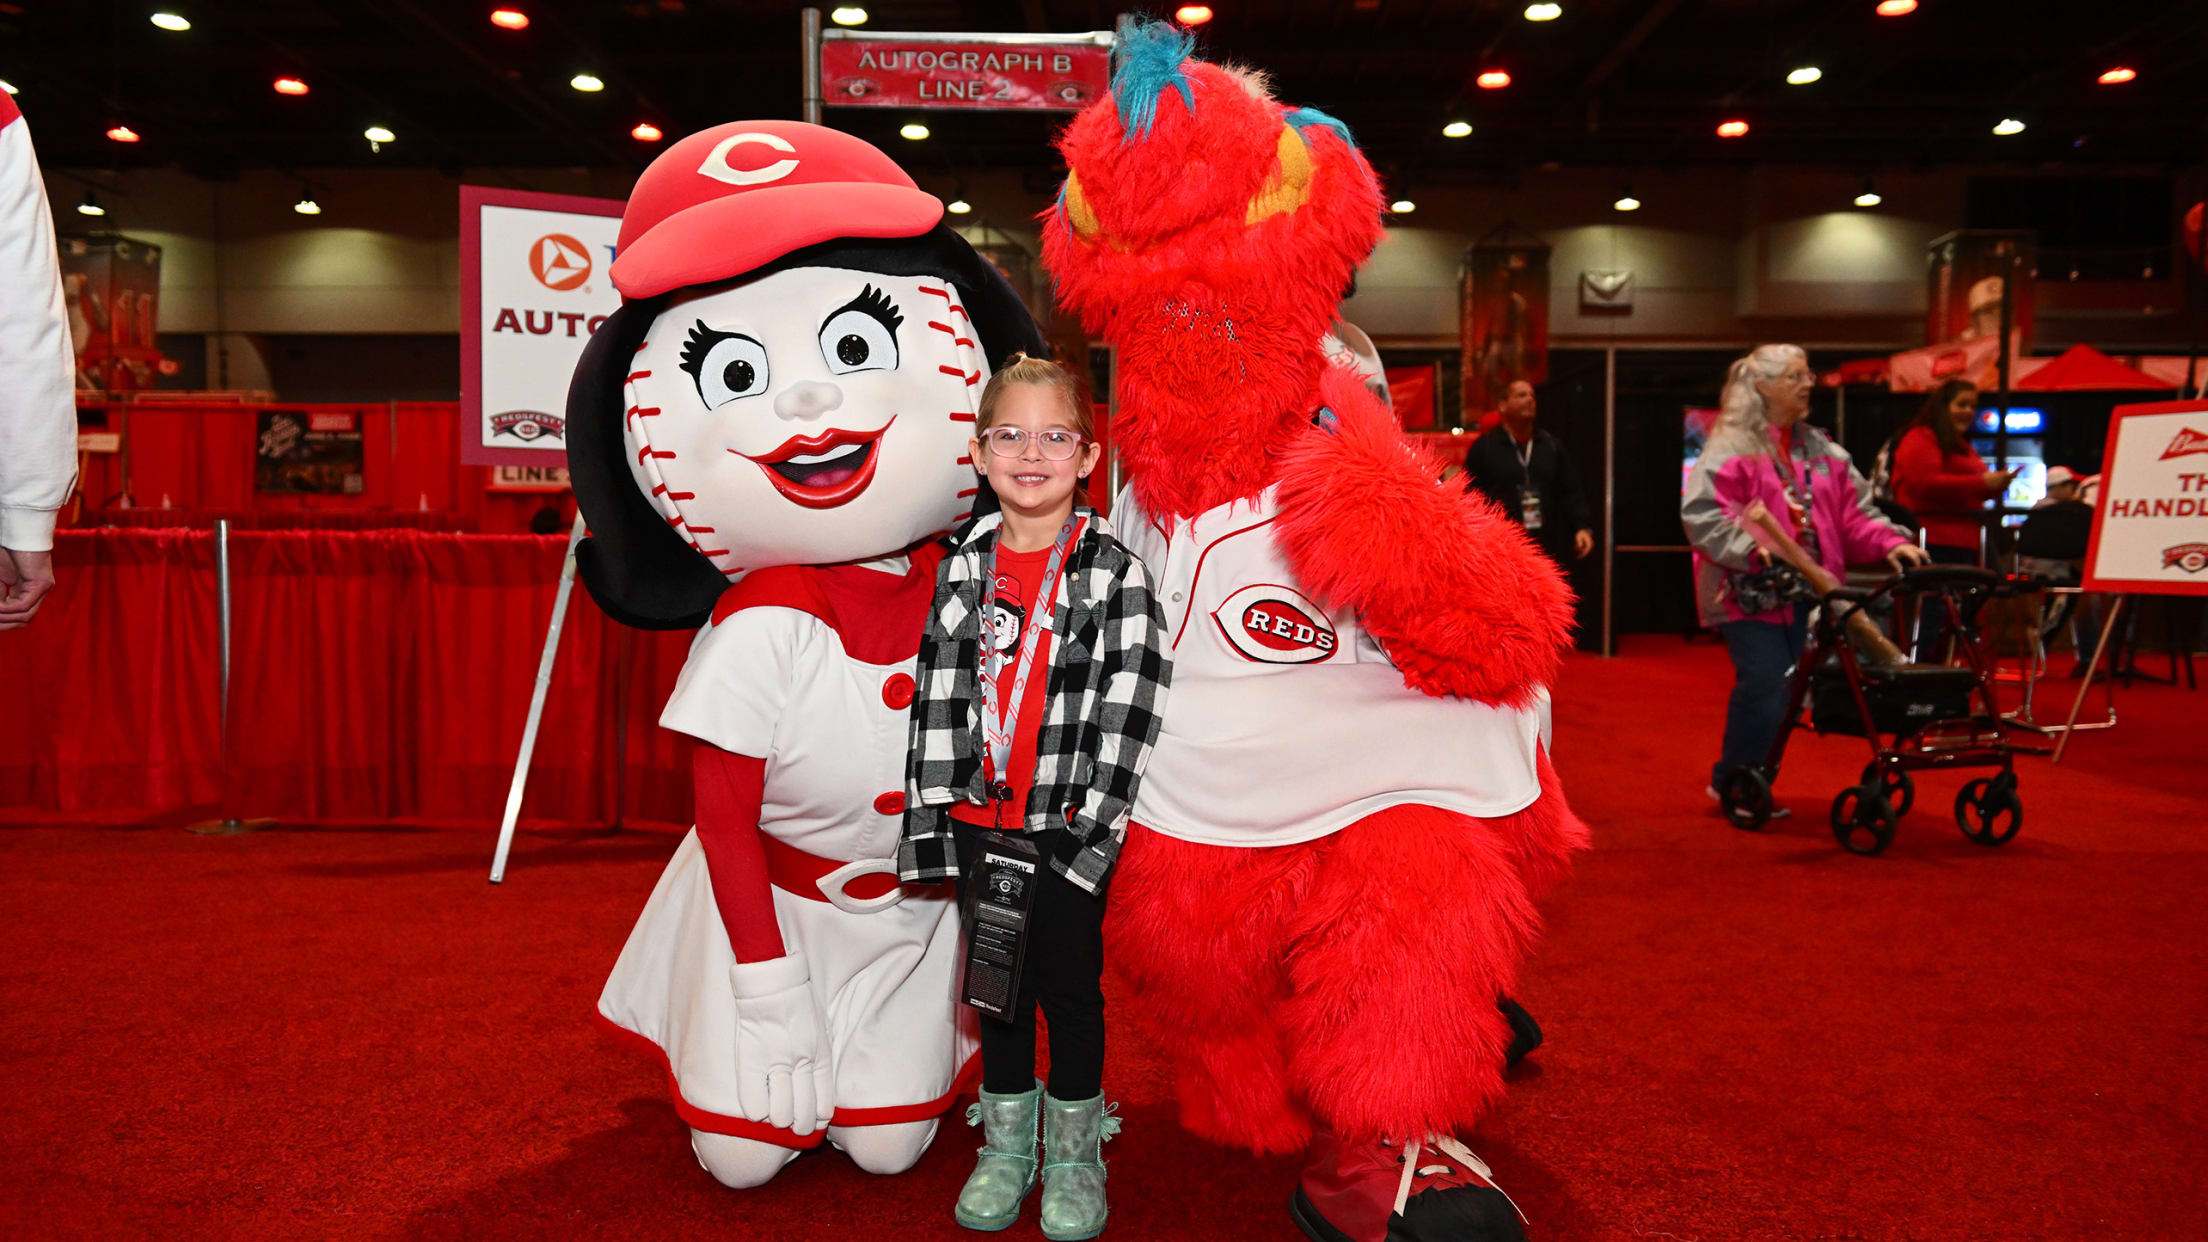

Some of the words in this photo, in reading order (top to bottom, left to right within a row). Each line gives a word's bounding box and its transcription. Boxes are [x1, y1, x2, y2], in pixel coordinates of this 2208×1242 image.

[858, 51, 1042, 72] AUTOGRAPH
[1053, 54, 1073, 73] B
[918, 80, 985, 99] LINE
[994, 80, 1013, 99] 2
[697, 132, 800, 186] C
[502, 467, 559, 482] LINE
[1247, 608, 1335, 650] REDS
[991, 858, 1029, 873] SATURDAY
